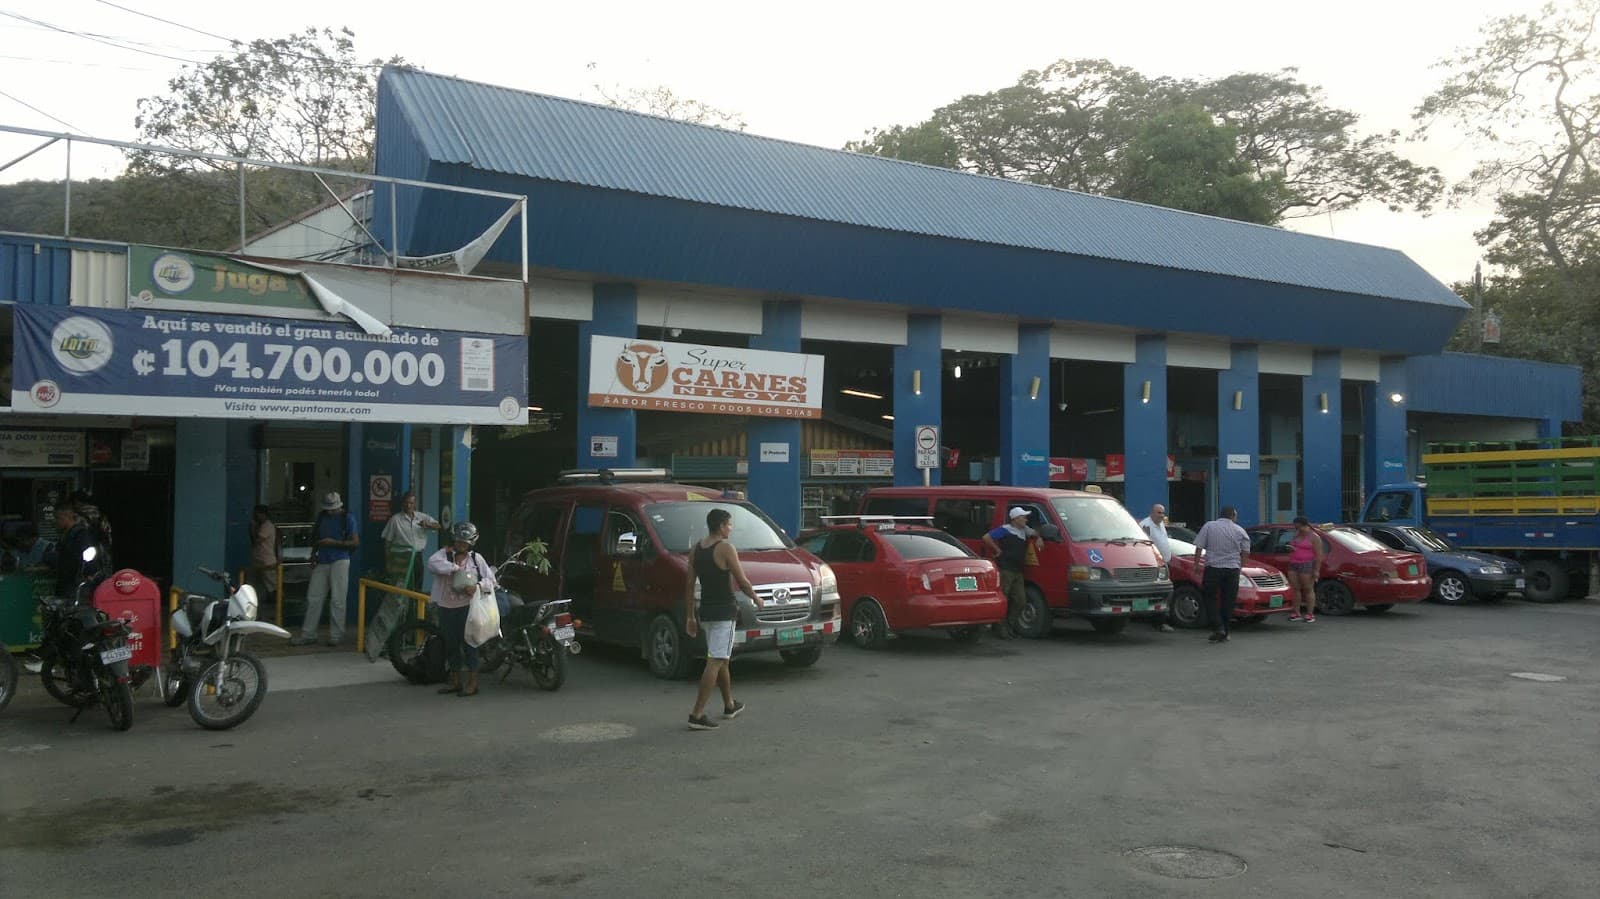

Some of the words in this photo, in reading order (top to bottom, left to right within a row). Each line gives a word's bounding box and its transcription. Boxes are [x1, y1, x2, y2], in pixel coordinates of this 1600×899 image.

[142, 316, 187, 333] Aquí
[191, 320, 210, 332] se
[214, 321, 272, 336] vendió
[275, 323, 290, 337] el
[294, 328, 331, 341] gran
[421, 333, 439, 346] de
[680, 348, 747, 371] Super
[671, 366, 807, 394] CARNES
[240, 384, 282, 394] también
[285, 387, 315, 396] podés
[318, 388, 352, 397] tenerlo
[355, 389, 380, 398] todo!
[679, 386, 801, 402] NICOYA
[260, 403, 371, 416] www.puntomax.com
[604, 396, 648, 408] SABOR
[655, 401, 704, 411] FRESCO
[712, 404, 752, 413] TODOS
[759, 407, 780, 415] LOS
